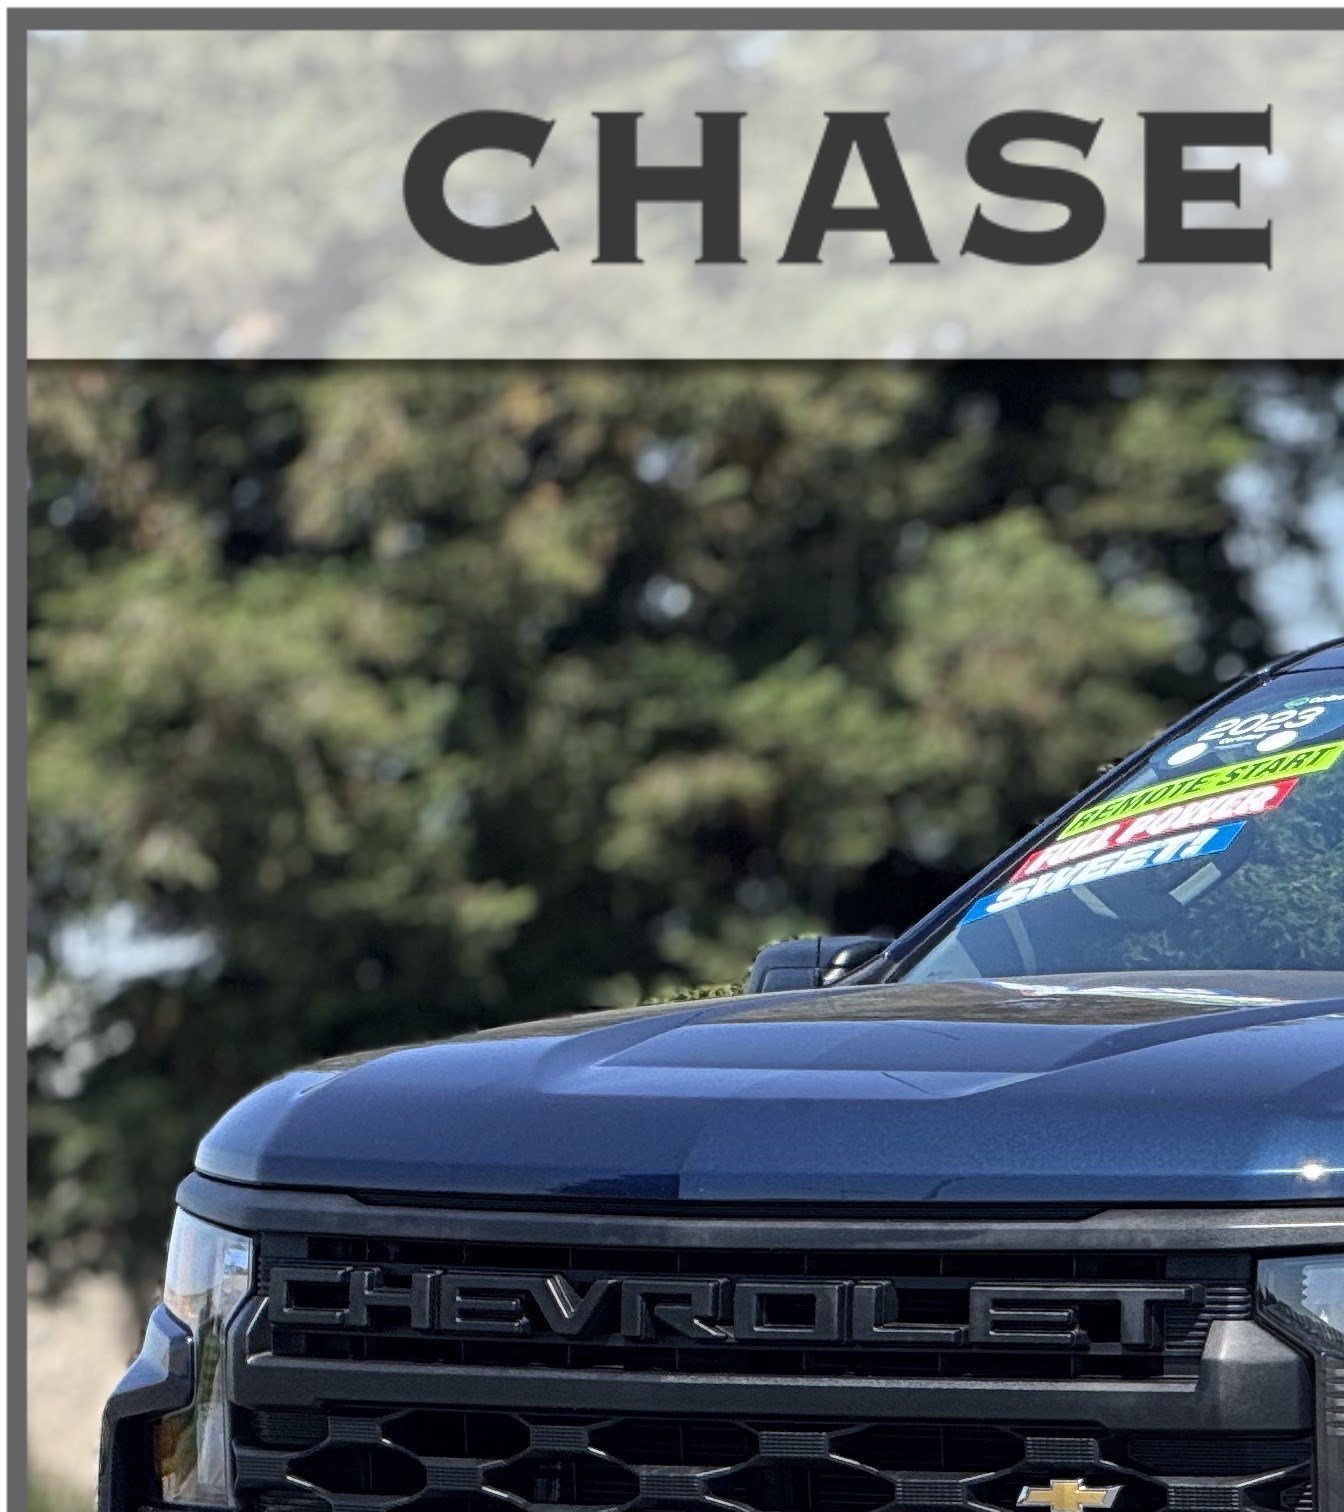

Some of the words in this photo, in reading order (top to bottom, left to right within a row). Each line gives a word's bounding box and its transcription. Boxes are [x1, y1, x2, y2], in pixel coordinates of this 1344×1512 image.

[1197, 706, 1327, 742] 2023
[1070, 774, 1210, 831] REMOTE
[1216, 747, 1339, 785] START
[1116, 784, 1281, 846] POWER
[986, 827, 1221, 914] SWEET!
[267, 1265, 1200, 1350] CHEVROLET
